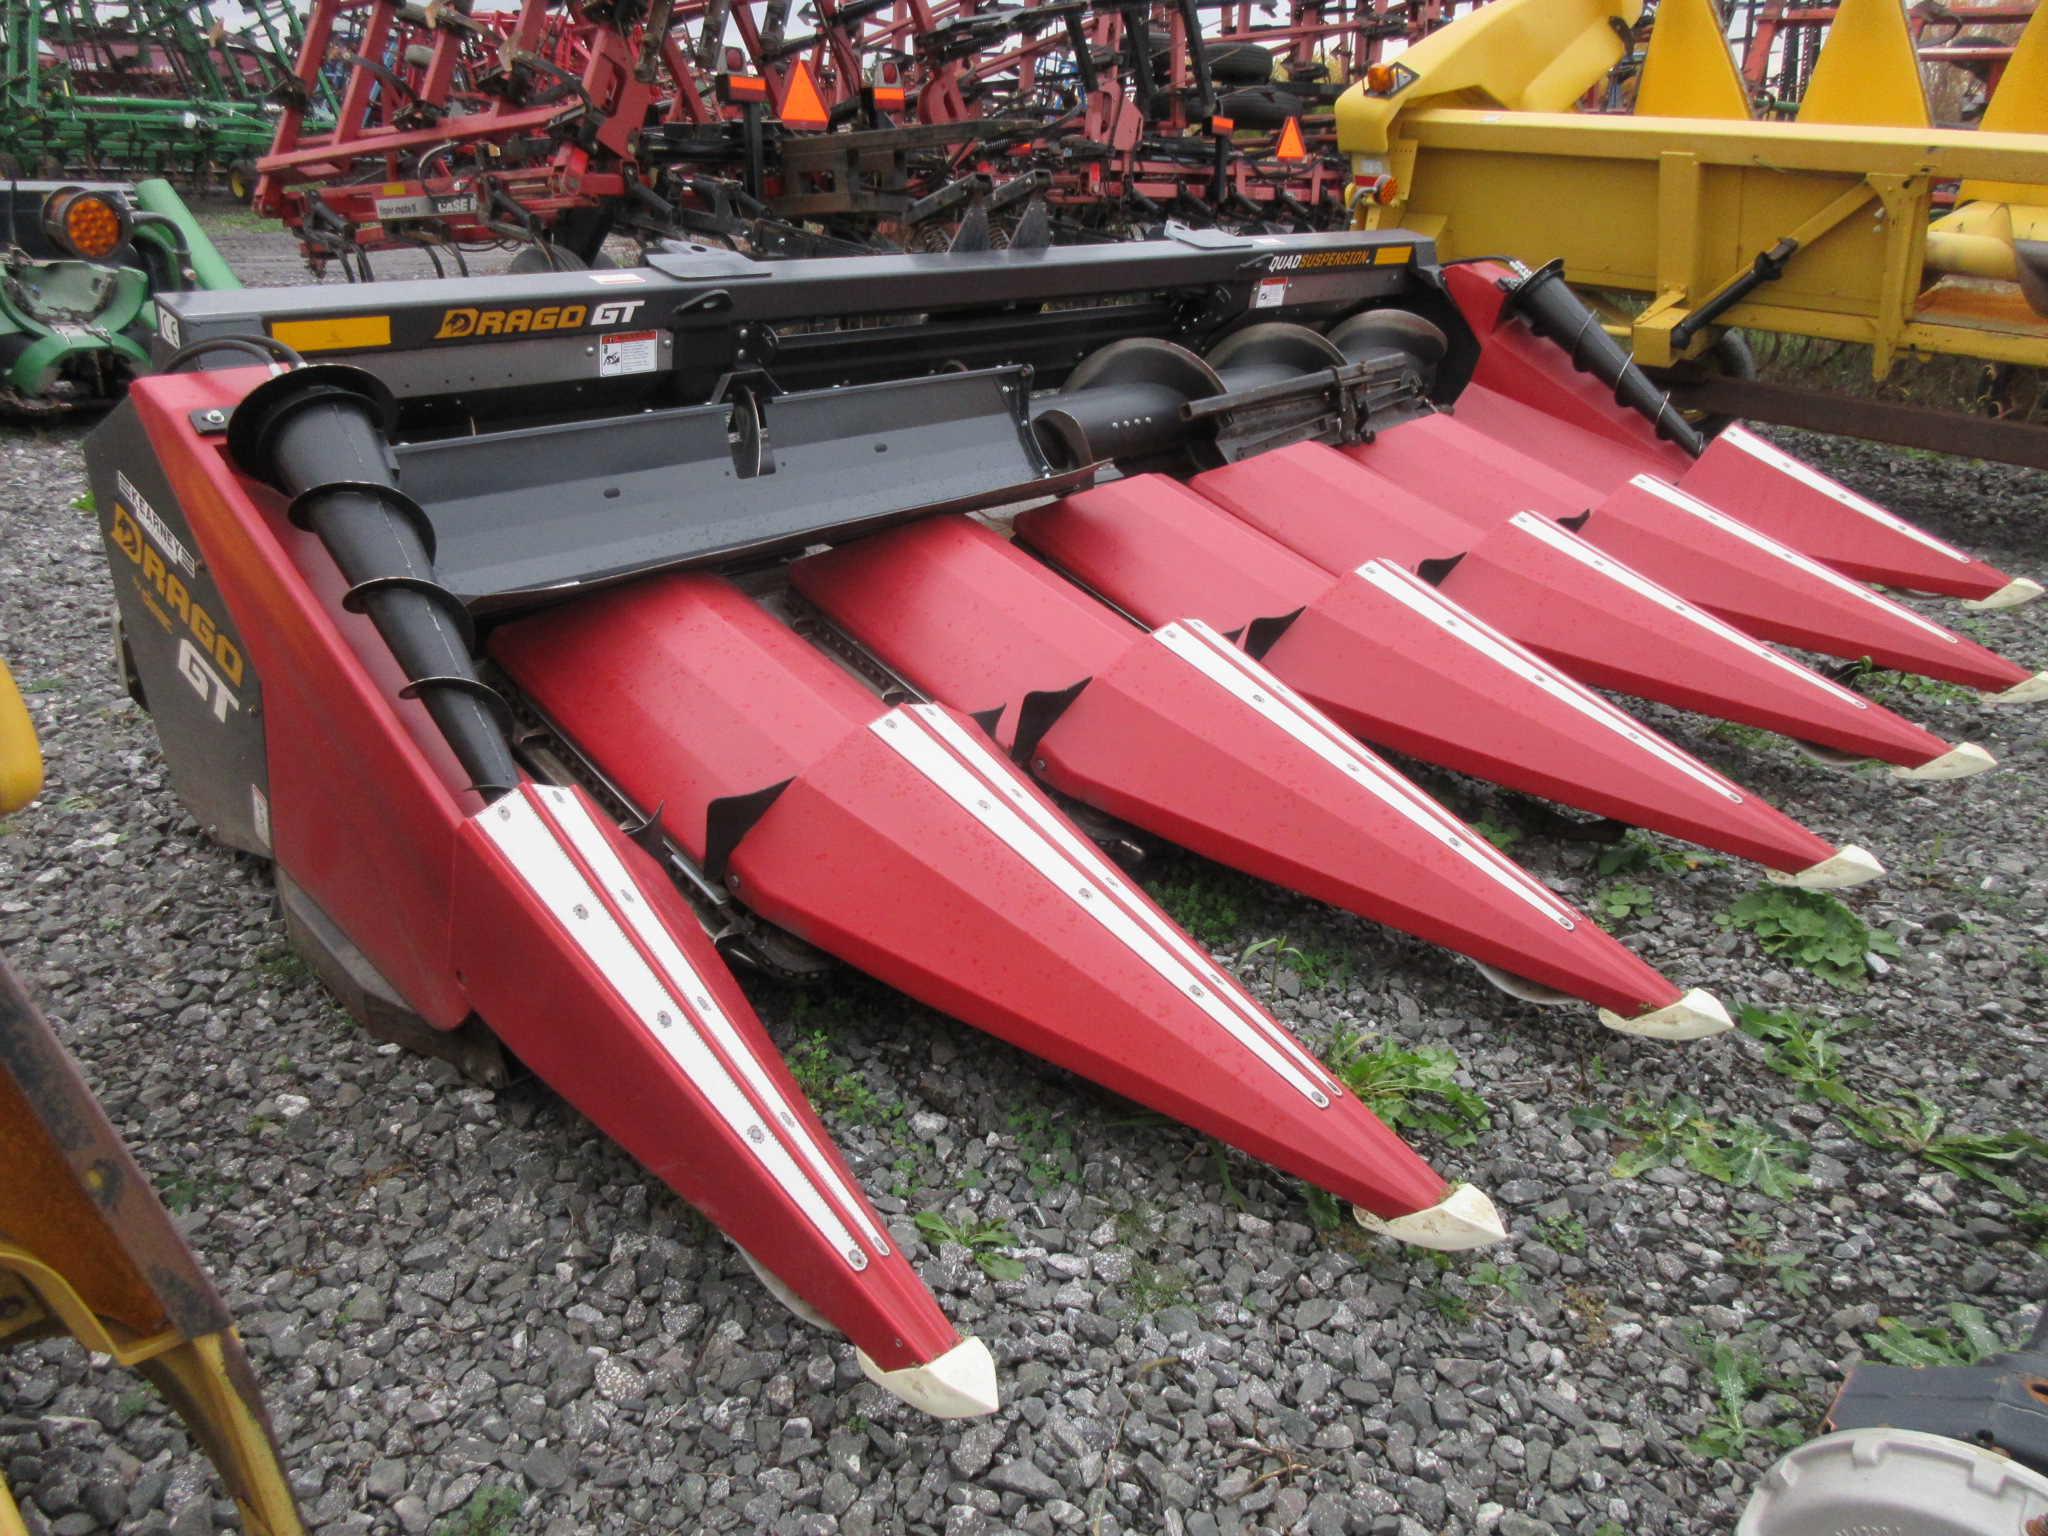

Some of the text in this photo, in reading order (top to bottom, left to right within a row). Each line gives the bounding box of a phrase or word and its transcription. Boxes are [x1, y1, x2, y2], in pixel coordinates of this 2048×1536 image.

[437, 198, 468, 213] CASE
[433, 300, 645, 339] DRAGO GT
[131, 487, 183, 558] KEARNEY
[111, 502, 243, 687] DRAGO
[178, 638, 240, 723] GT
